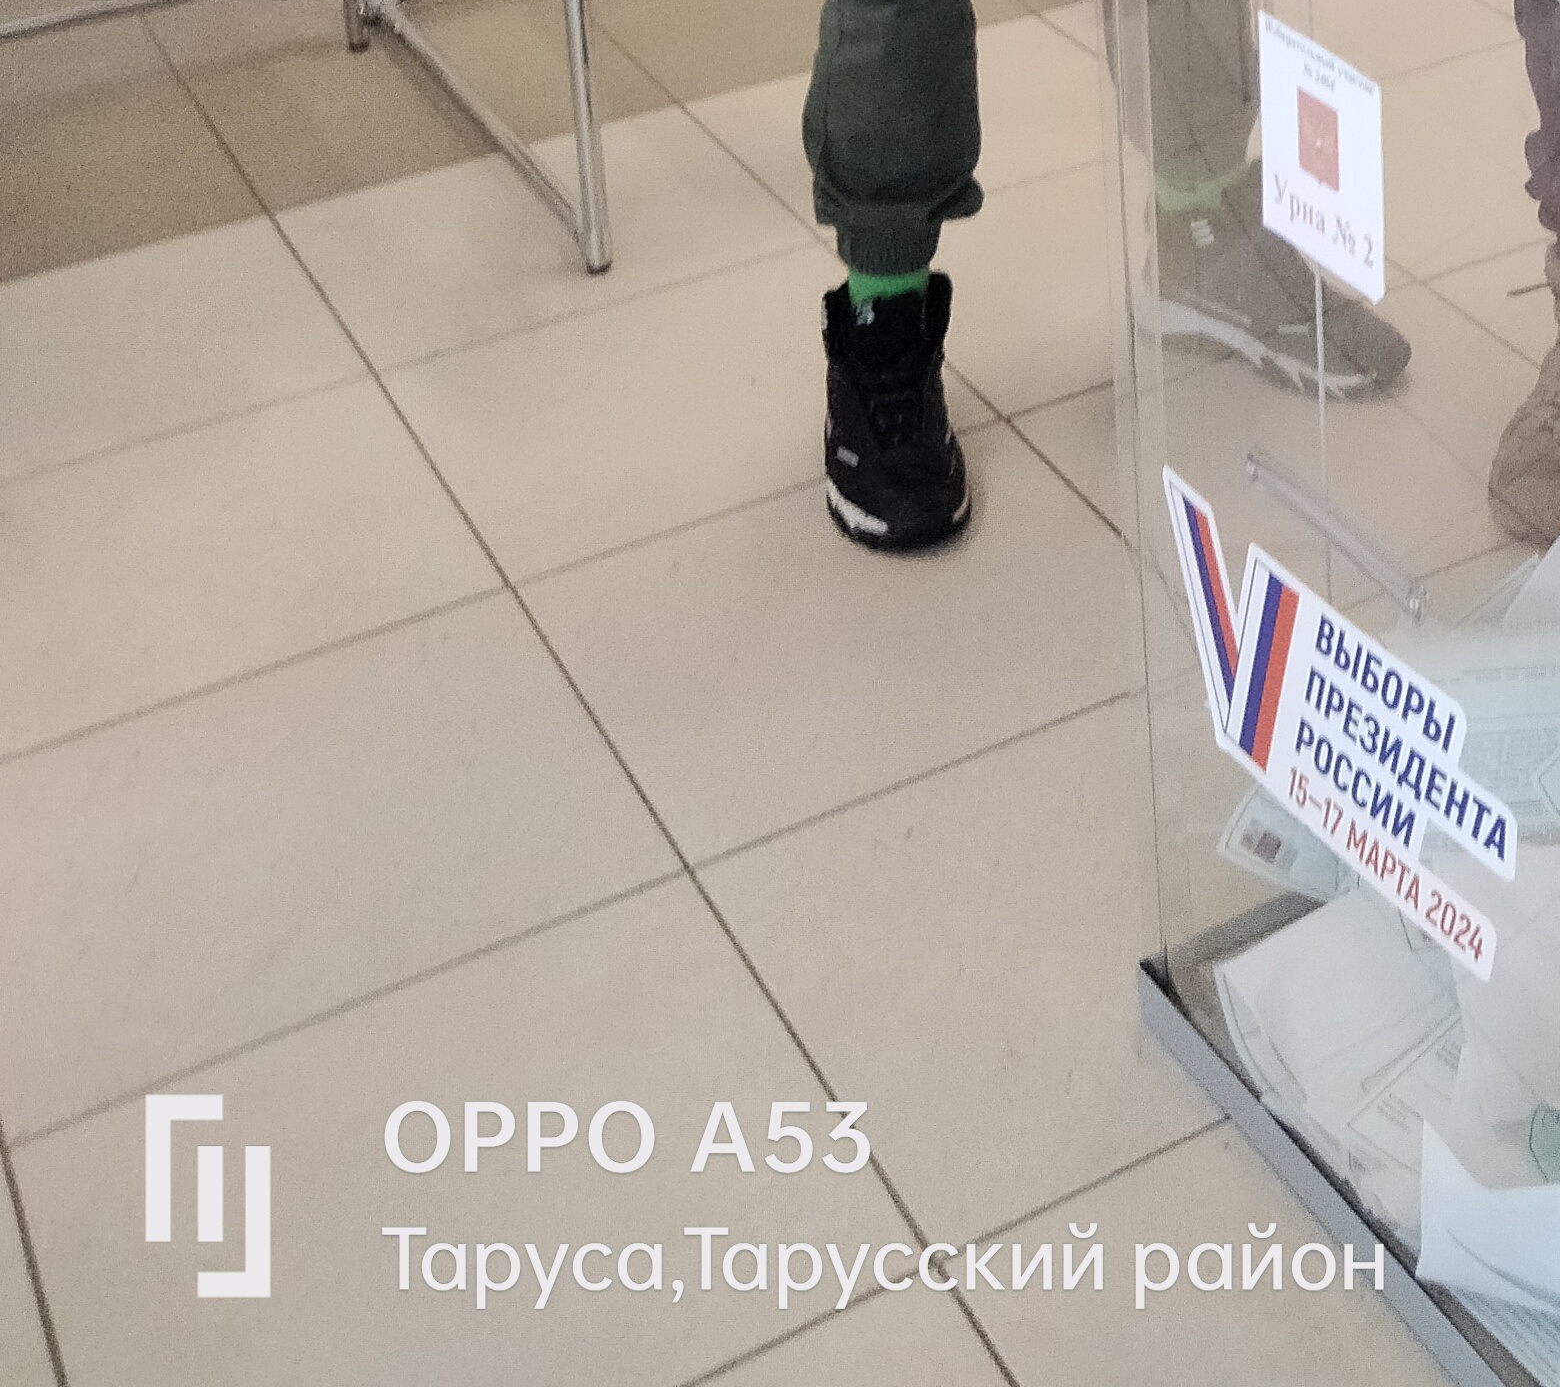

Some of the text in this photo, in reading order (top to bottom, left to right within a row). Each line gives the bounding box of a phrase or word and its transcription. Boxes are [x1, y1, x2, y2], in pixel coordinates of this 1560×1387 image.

[1274, 170, 1326, 238] Урна
[1363, 233, 1374, 270] 2
[1314, 613, 1458, 754] ВЫБОРЫ
[1294, 715, 1417, 850] РОССИИ
[1304, 665, 1509, 863] ПРЕЗИДЕНТА
[1345, 817, 1421, 912] МАРТА
[1424, 888, 1484, 964] 2024
